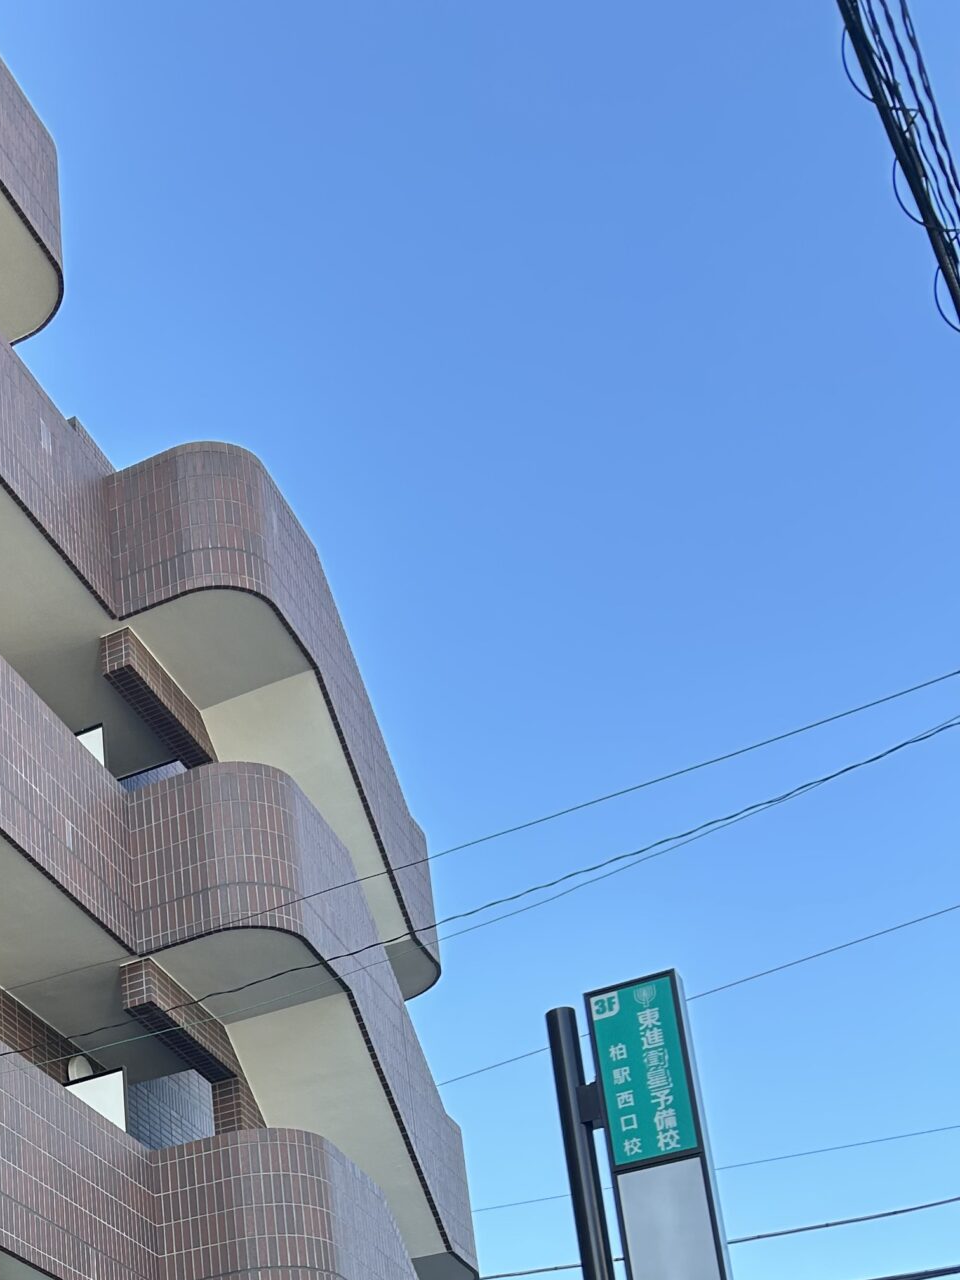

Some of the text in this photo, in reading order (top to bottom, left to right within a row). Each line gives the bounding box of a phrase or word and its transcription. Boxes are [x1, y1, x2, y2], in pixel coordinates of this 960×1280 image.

[593, 998, 618, 1016] 3F
[609, 1043, 642, 1156] 柏駅西口校
[637, 1007, 681, 1151] 東進衛星予備校
